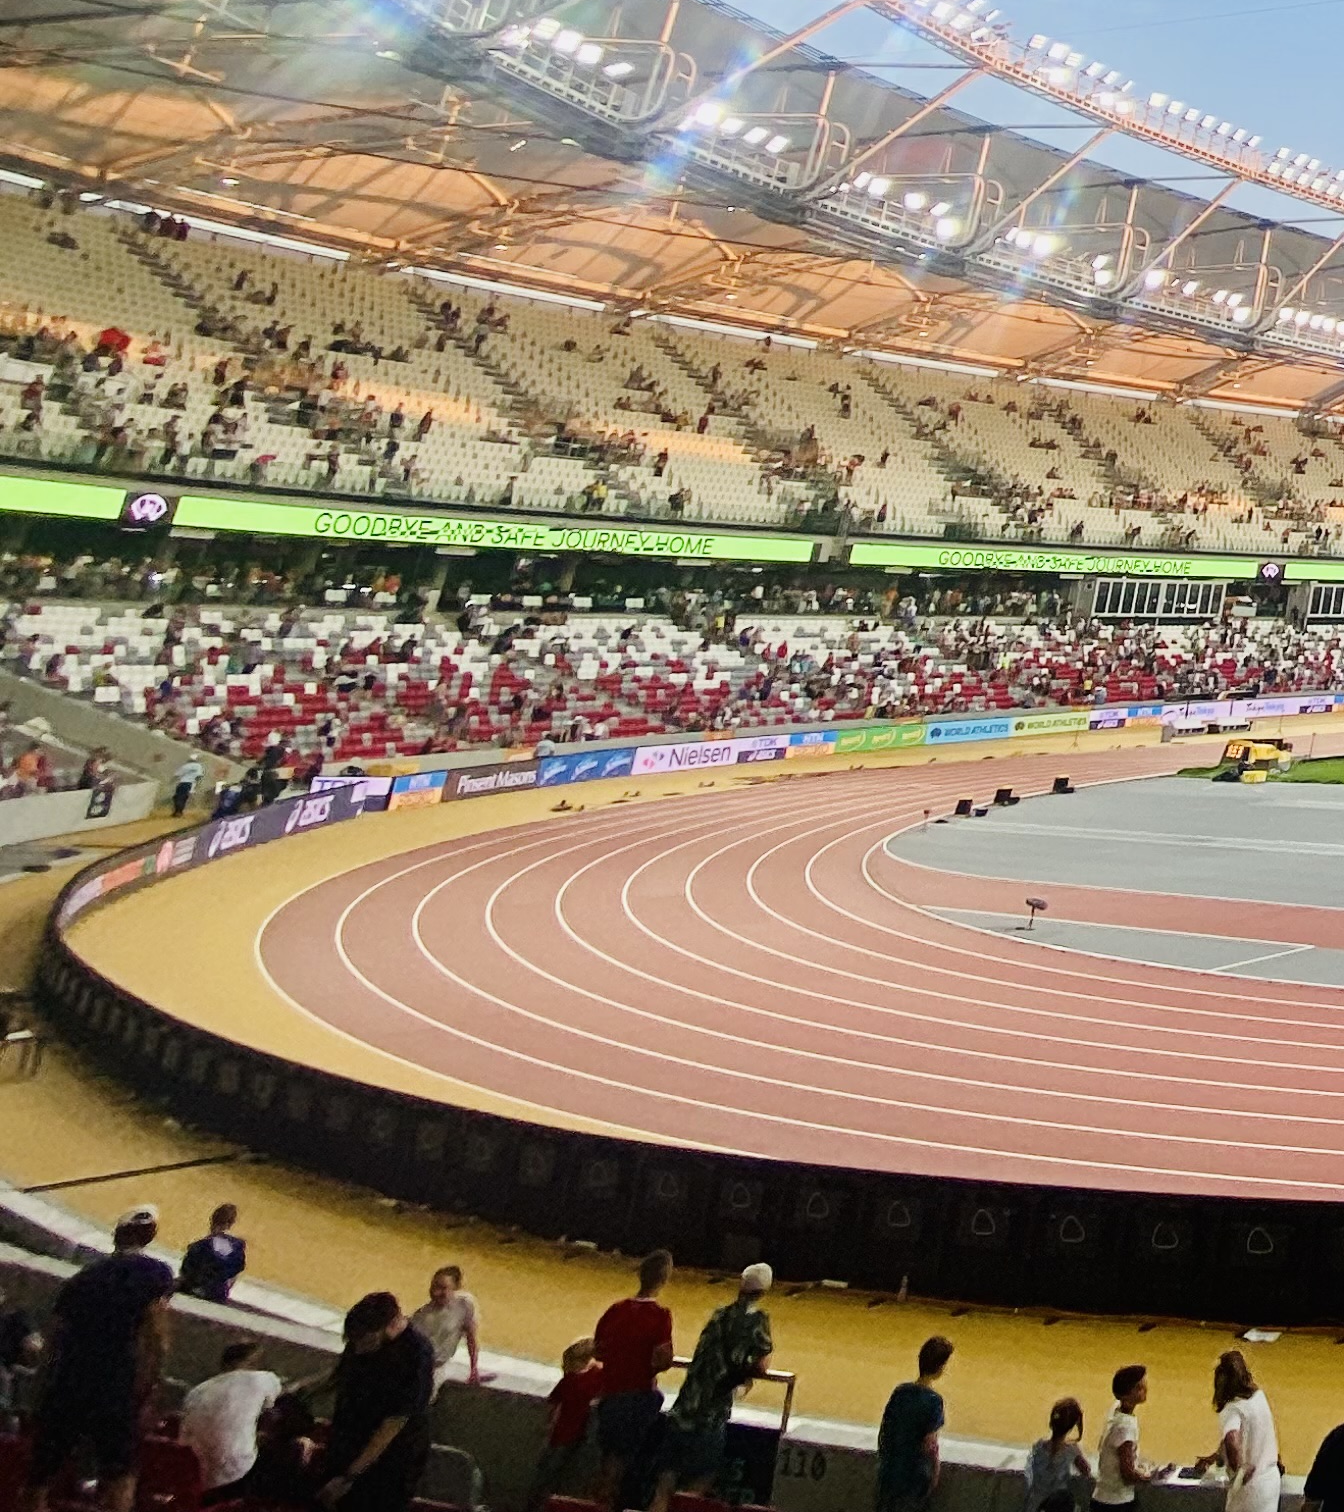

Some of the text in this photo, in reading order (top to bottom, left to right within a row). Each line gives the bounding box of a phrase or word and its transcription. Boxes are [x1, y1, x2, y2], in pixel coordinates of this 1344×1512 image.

[315, 512, 433, 539] GOODBYE
[491, 524, 546, 546] SAFE
[552, 528, 651, 549] JOURNEY
[656, 535, 715, 555] HOME
[1154, 560, 1192, 575] HOME
[944, 723, 1009, 737] WORLD ATHLETICS
[1027, 717, 1087, 729] WORLD ATHLETICS
[669, 746, 731, 768] Nielsen
[496, 770, 538, 788] Masons
[780, 1447, 828, 1481] 110
